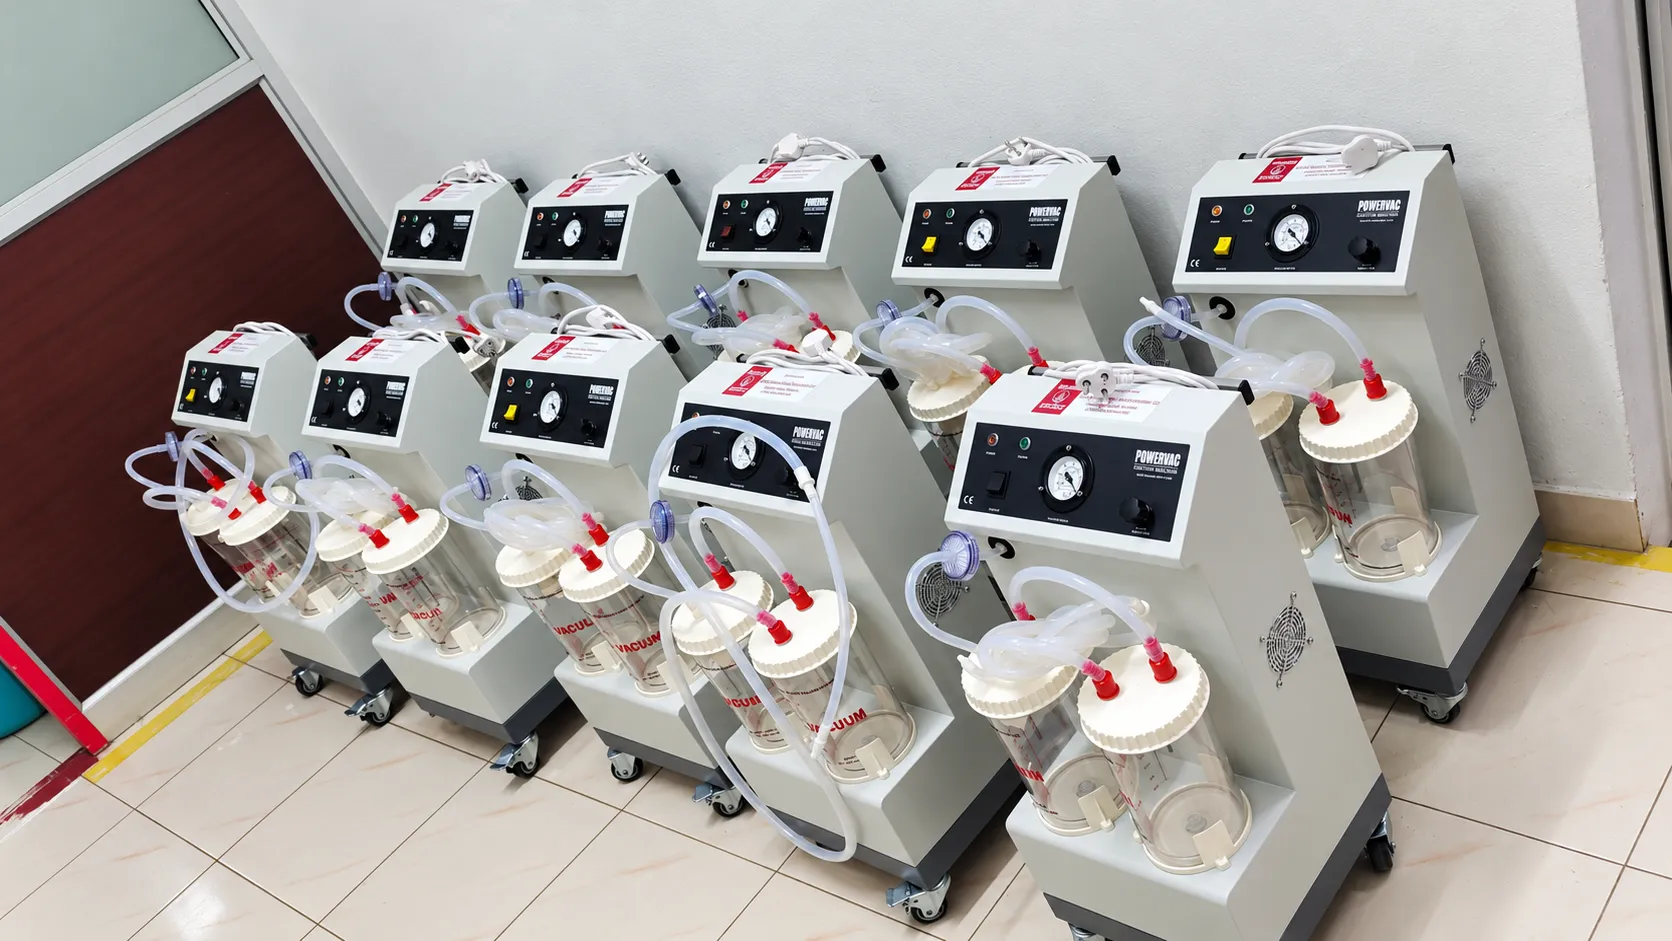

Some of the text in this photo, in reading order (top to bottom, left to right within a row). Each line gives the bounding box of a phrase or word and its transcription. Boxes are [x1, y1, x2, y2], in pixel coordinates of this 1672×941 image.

[1029, 206, 1062, 217] POWERVAC
[1357, 199, 1402, 212] POWERVAC
[1134, 449, 1181, 467] POWERVAC
